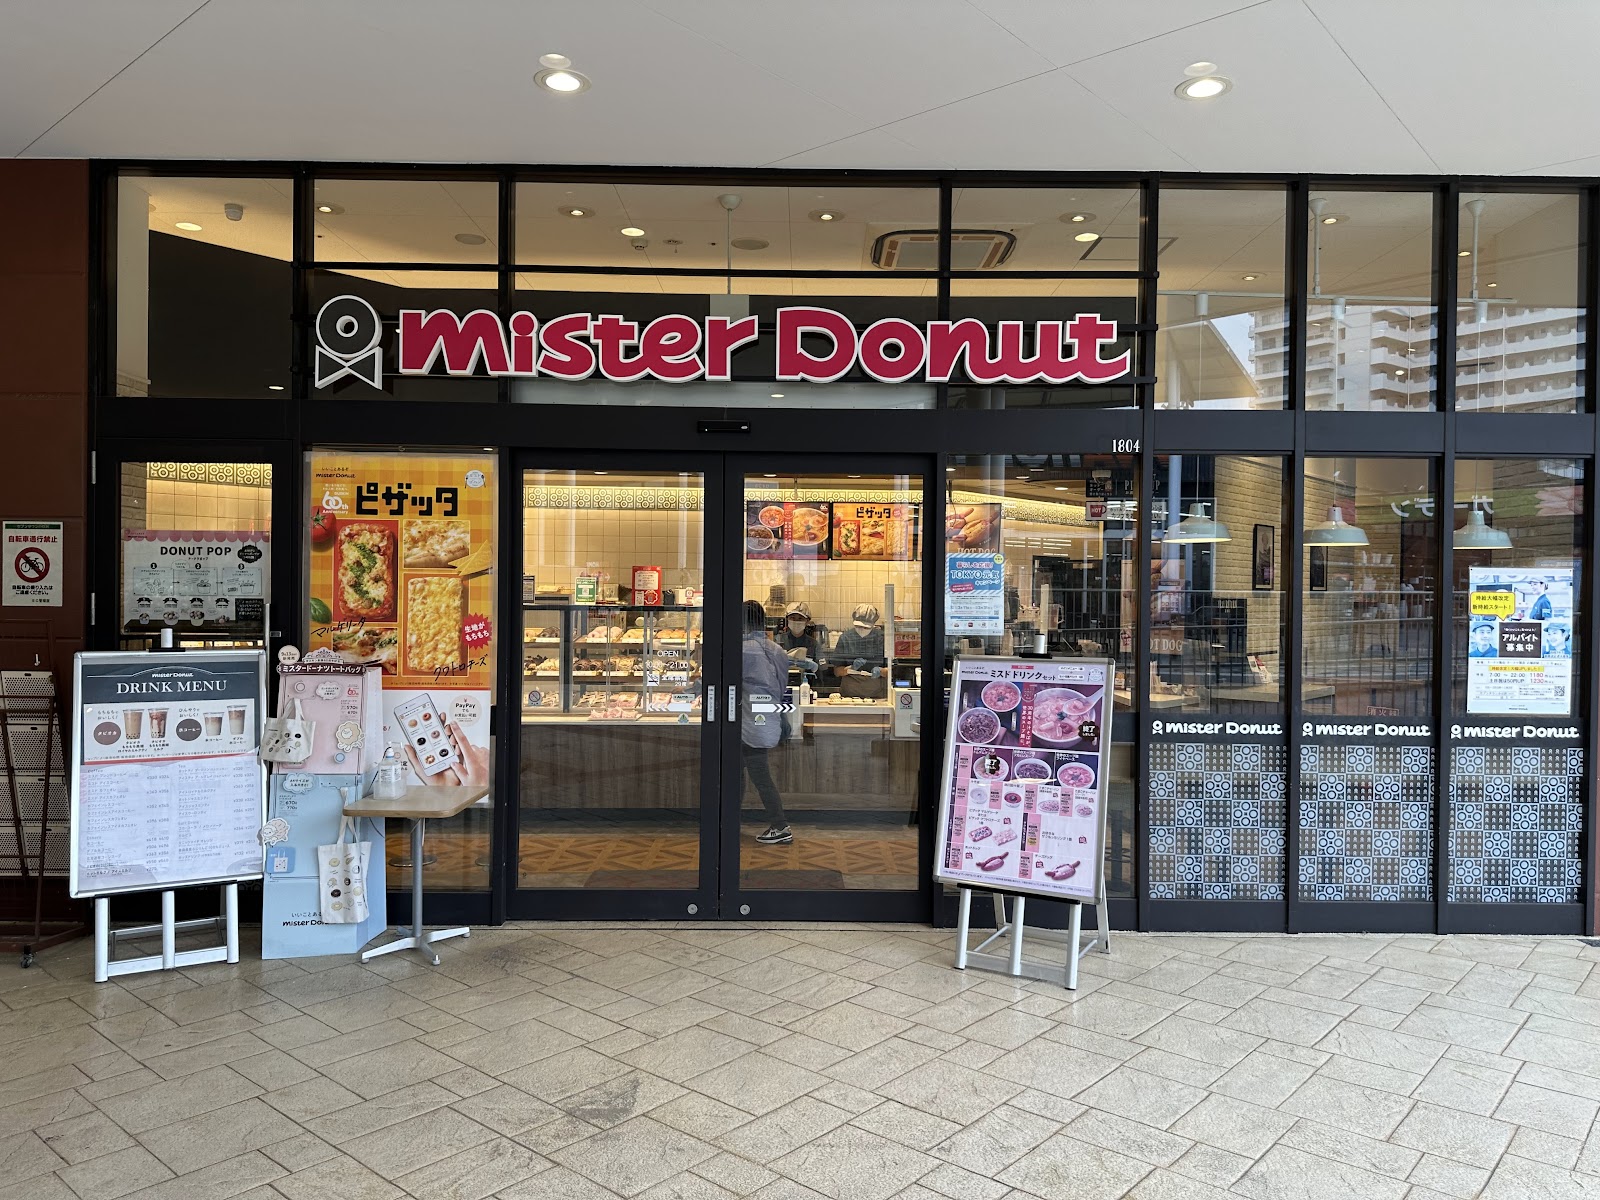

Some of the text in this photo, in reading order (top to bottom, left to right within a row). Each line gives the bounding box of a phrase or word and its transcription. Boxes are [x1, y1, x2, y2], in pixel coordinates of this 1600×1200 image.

[775, 305, 1131, 385] Donut
[1112, 439, 1140, 452] 1804
[356, 482, 458, 516] ピザッタ
[856, 507, 891, 518] ピザッタ
[8, 535, 58, 543] 自転車通行禁止
[160, 546, 203, 556] DONUT
[207, 546, 232, 556] POP
[464, 622, 485, 633] 生地が
[465, 630, 489, 642] もちもち
[1502, 633, 1538, 642] アルバイト
[1162, 638, 1183, 651] DOG
[1506, 643, 1534, 652] 募集中
[282, 665, 361, 673] ミスタードーナツトートバッグ
[116, 680, 227, 694] DRINK MENU
[1082, 725, 1096, 733] 終了
[1225, 721, 1283, 735] Donut
[1375, 723, 1431, 738] Donut
[1523, 726, 1580, 739] Donut
